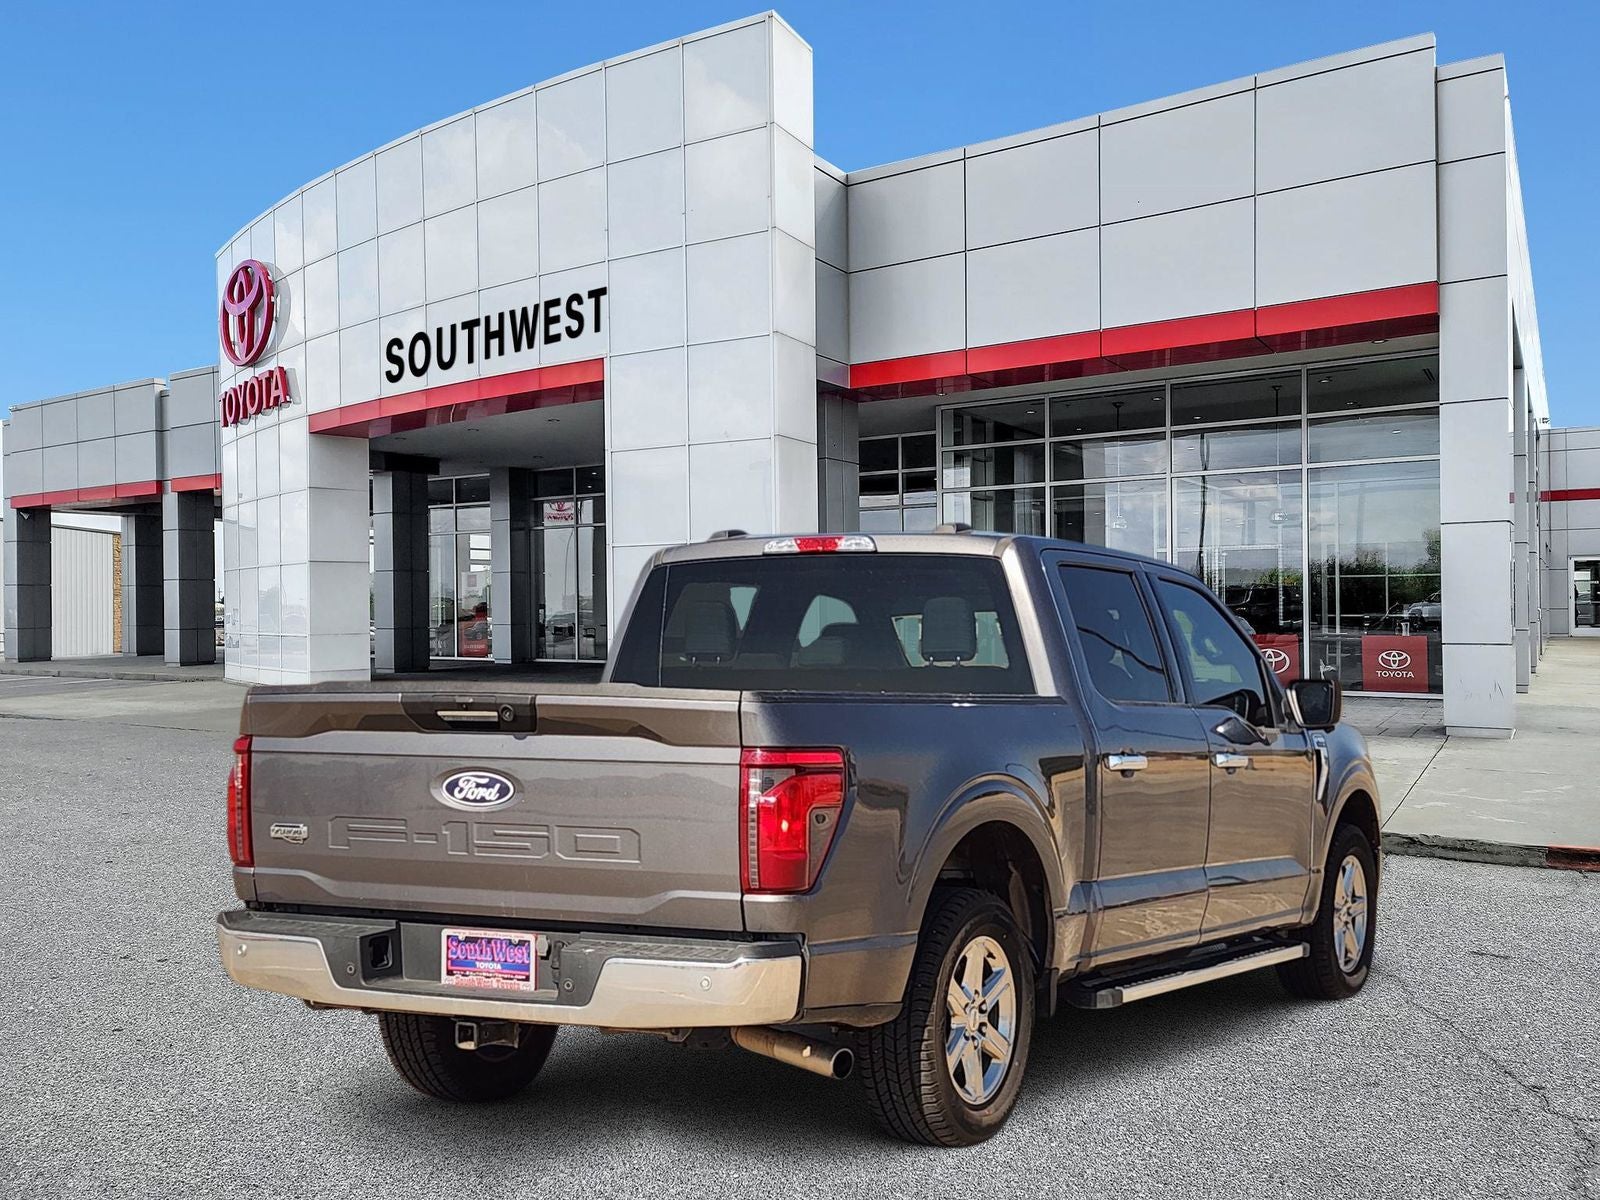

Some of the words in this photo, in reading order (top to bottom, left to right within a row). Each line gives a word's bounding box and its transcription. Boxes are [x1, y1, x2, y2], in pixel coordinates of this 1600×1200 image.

[385, 286, 607, 383] SOUTHWEST
[219, 366, 289, 427] TOYOTA
[1375, 670, 1415, 678] TOYOTA
[454, 776, 500, 800] Ford
[328, 816, 641, 863] F-150
[448, 936, 530, 964] SouthWest
[475, 961, 502, 970] TOYOTA
